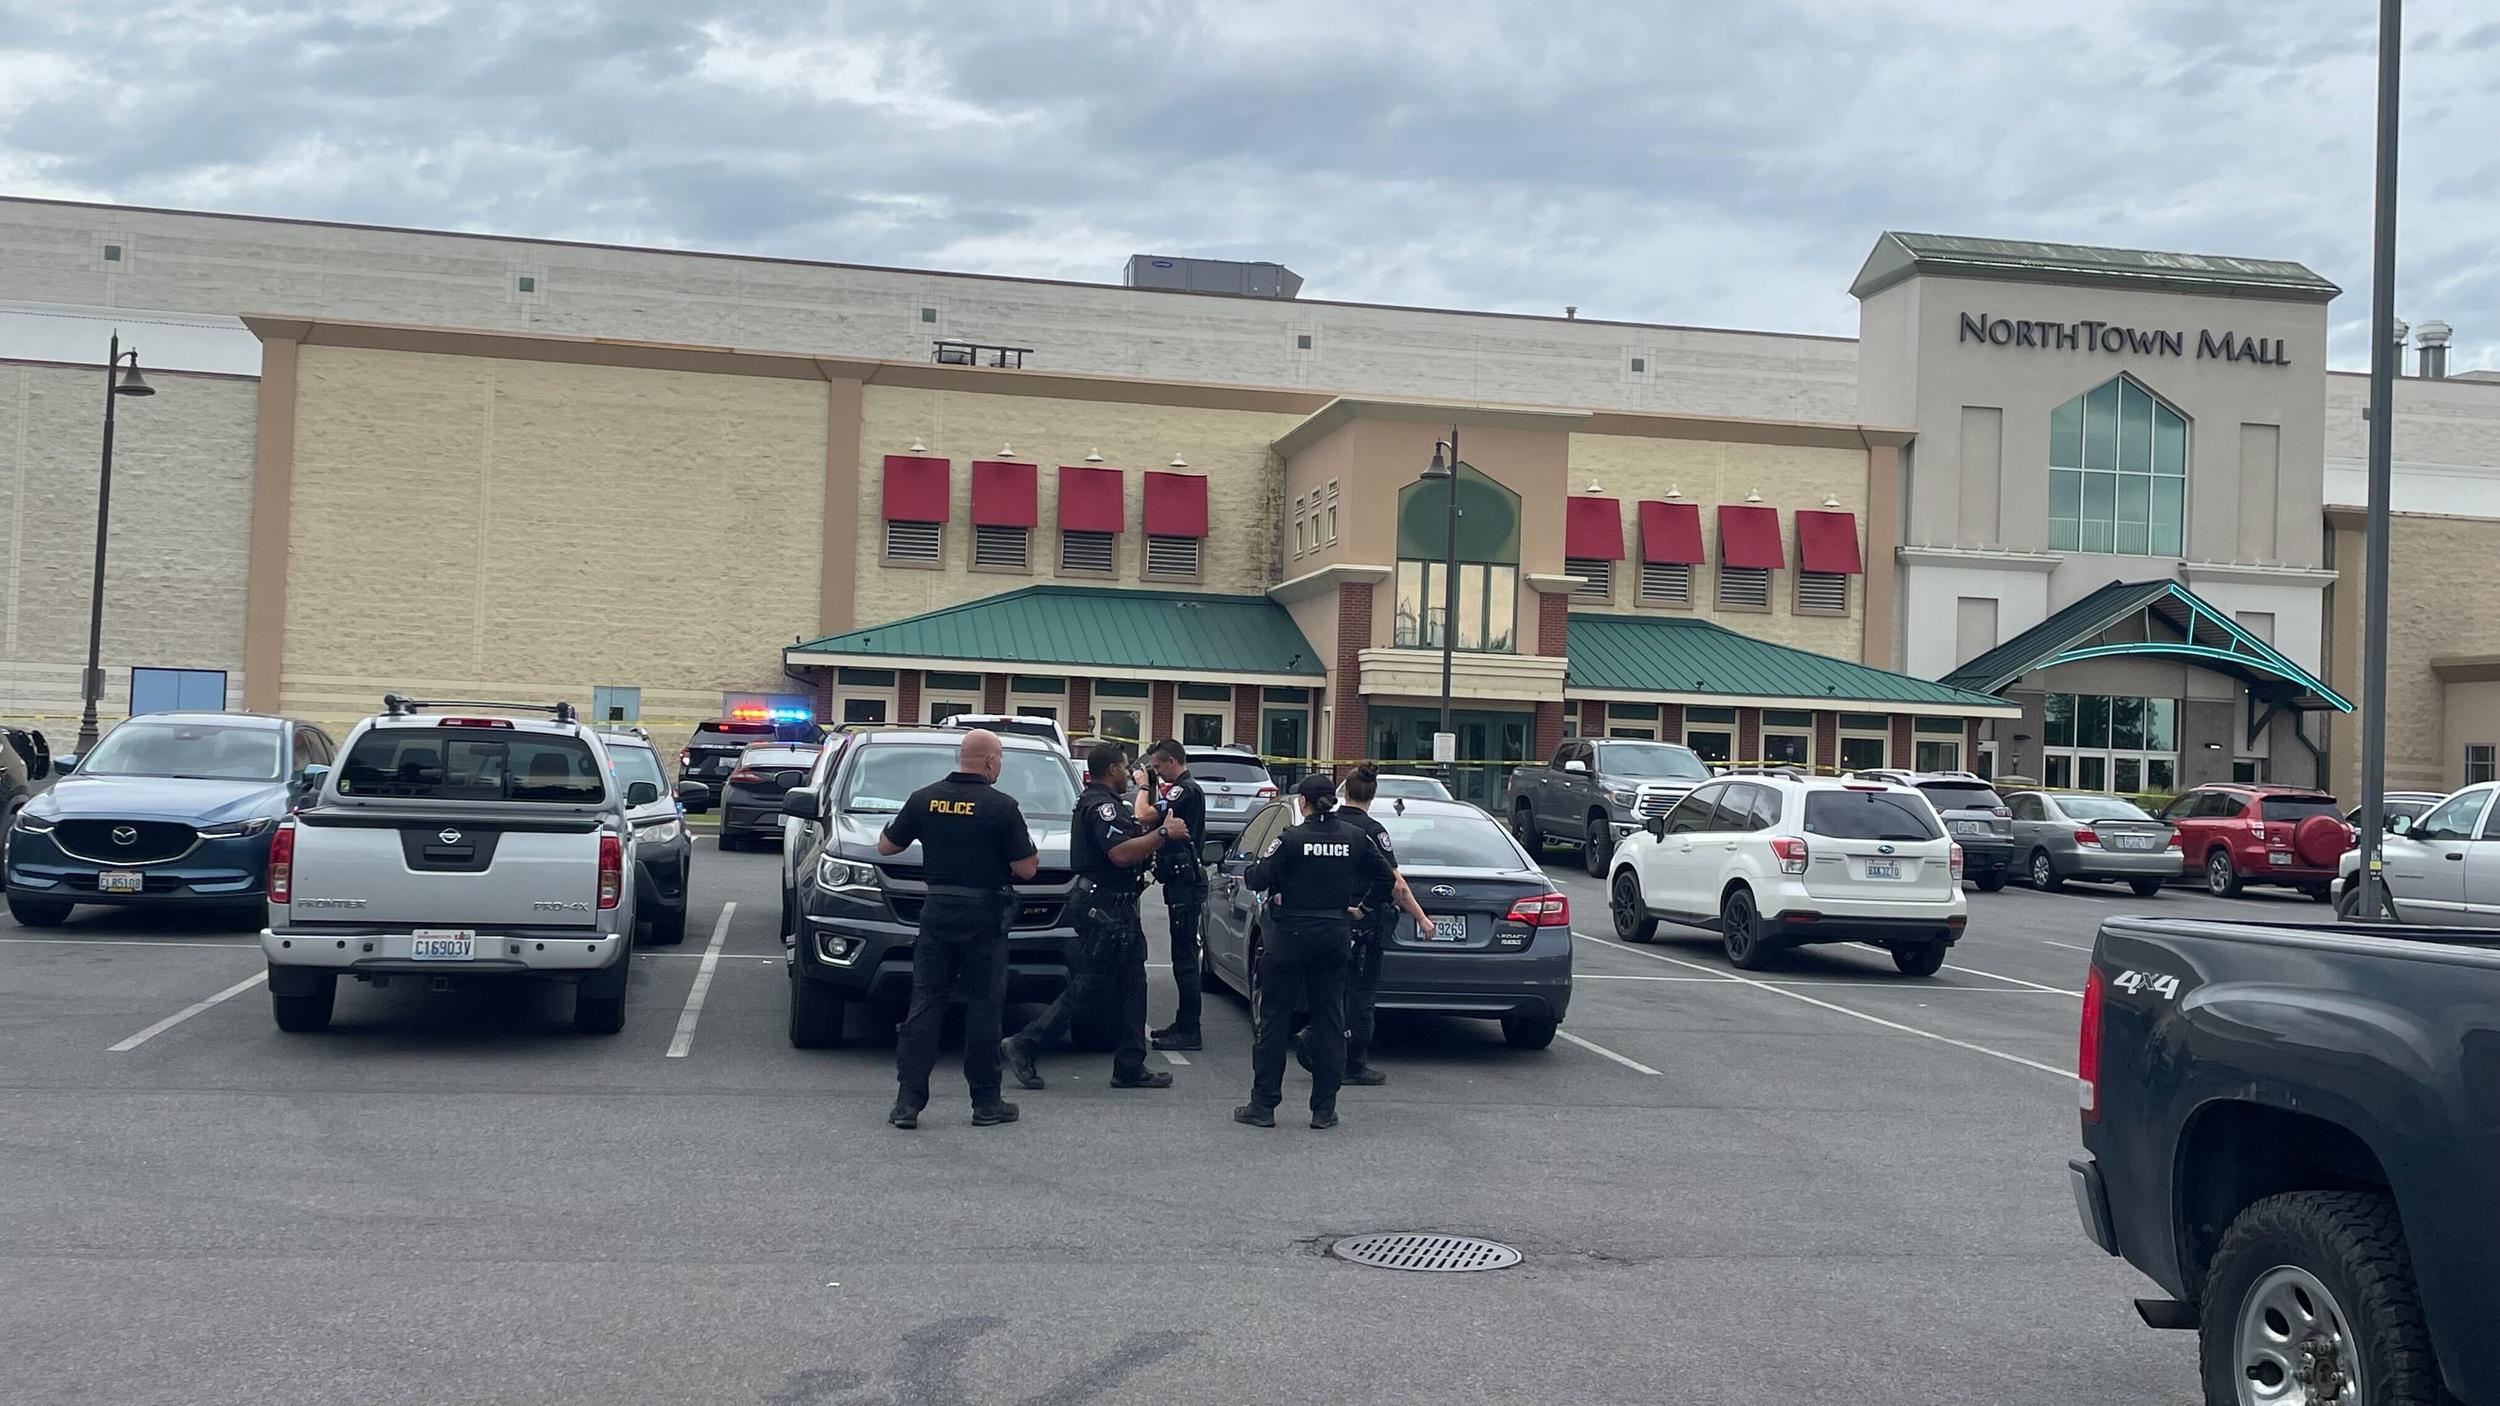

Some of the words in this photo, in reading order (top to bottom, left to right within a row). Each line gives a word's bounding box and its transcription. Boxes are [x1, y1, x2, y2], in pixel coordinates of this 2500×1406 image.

[929, 799, 976, 815] POLICE
[1303, 843, 1350, 857] POLICE
[297, 898, 367, 909] FRONTIER
[533, 901, 589, 911] PRO-4X
[415, 940, 471, 956] C16903V
